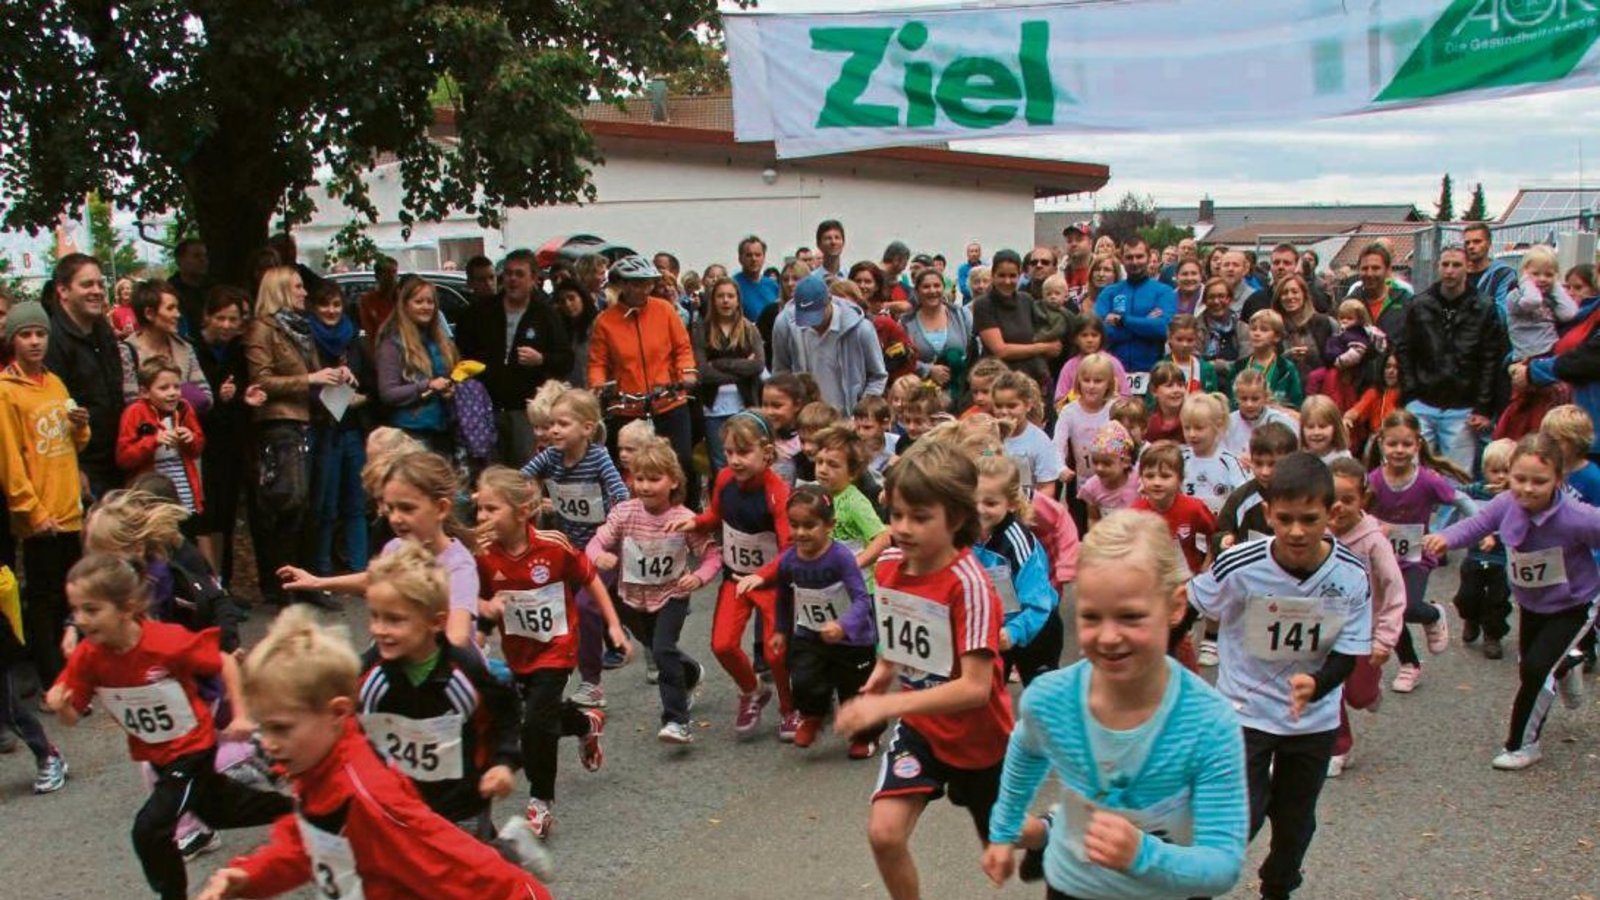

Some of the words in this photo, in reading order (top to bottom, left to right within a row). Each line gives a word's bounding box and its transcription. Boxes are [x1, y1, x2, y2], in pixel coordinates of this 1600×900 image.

[1444, 41, 1468, 53] Die
[809, 21, 1055, 128] Ziel
[558, 497, 590, 517] 249
[637, 556, 674, 577] 142
[729, 545, 764, 567] 153
[1511, 562, 1547, 582] 167
[515, 607, 554, 633] 158
[802, 602, 838, 624] 151
[882, 615, 931, 660] 146
[1267, 621, 1322, 652] 141
[124, 704, 174, 733] 465
[386, 732, 440, 772] 245
